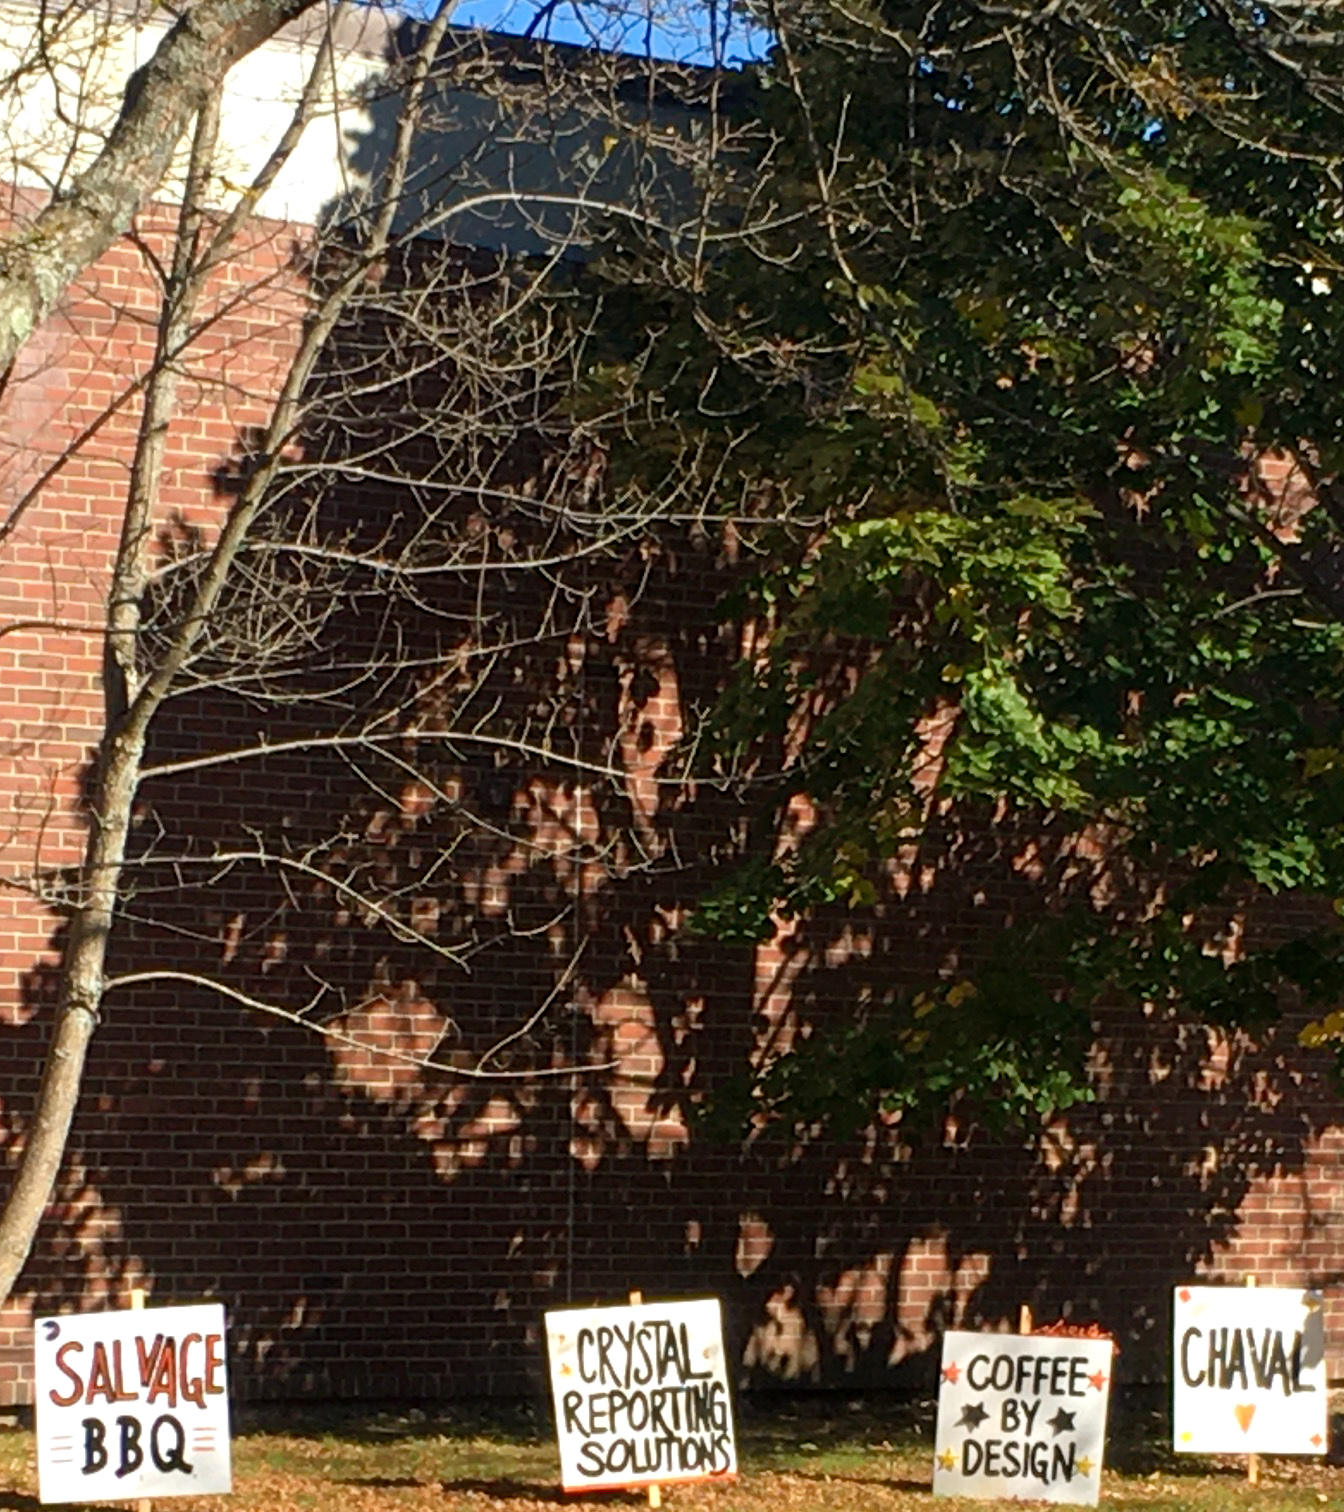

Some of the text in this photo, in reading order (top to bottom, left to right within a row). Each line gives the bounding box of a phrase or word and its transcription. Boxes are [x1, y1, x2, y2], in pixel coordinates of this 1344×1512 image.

[49, 1333, 224, 1409] SALVAGE
[577, 1320, 713, 1389] CRYSTAL
[966, 1354, 1089, 1397] COFFEE
[1181, 1326, 1316, 1397] CHAVAL
[562, 1380, 728, 1438] REPORTING
[1001, 1398, 1041, 1436] BY
[81, 1414, 193, 1478] BBQ
[576, 1432, 731, 1477] SOLUTIONS
[962, 1439, 1076, 1485] DESIGN
